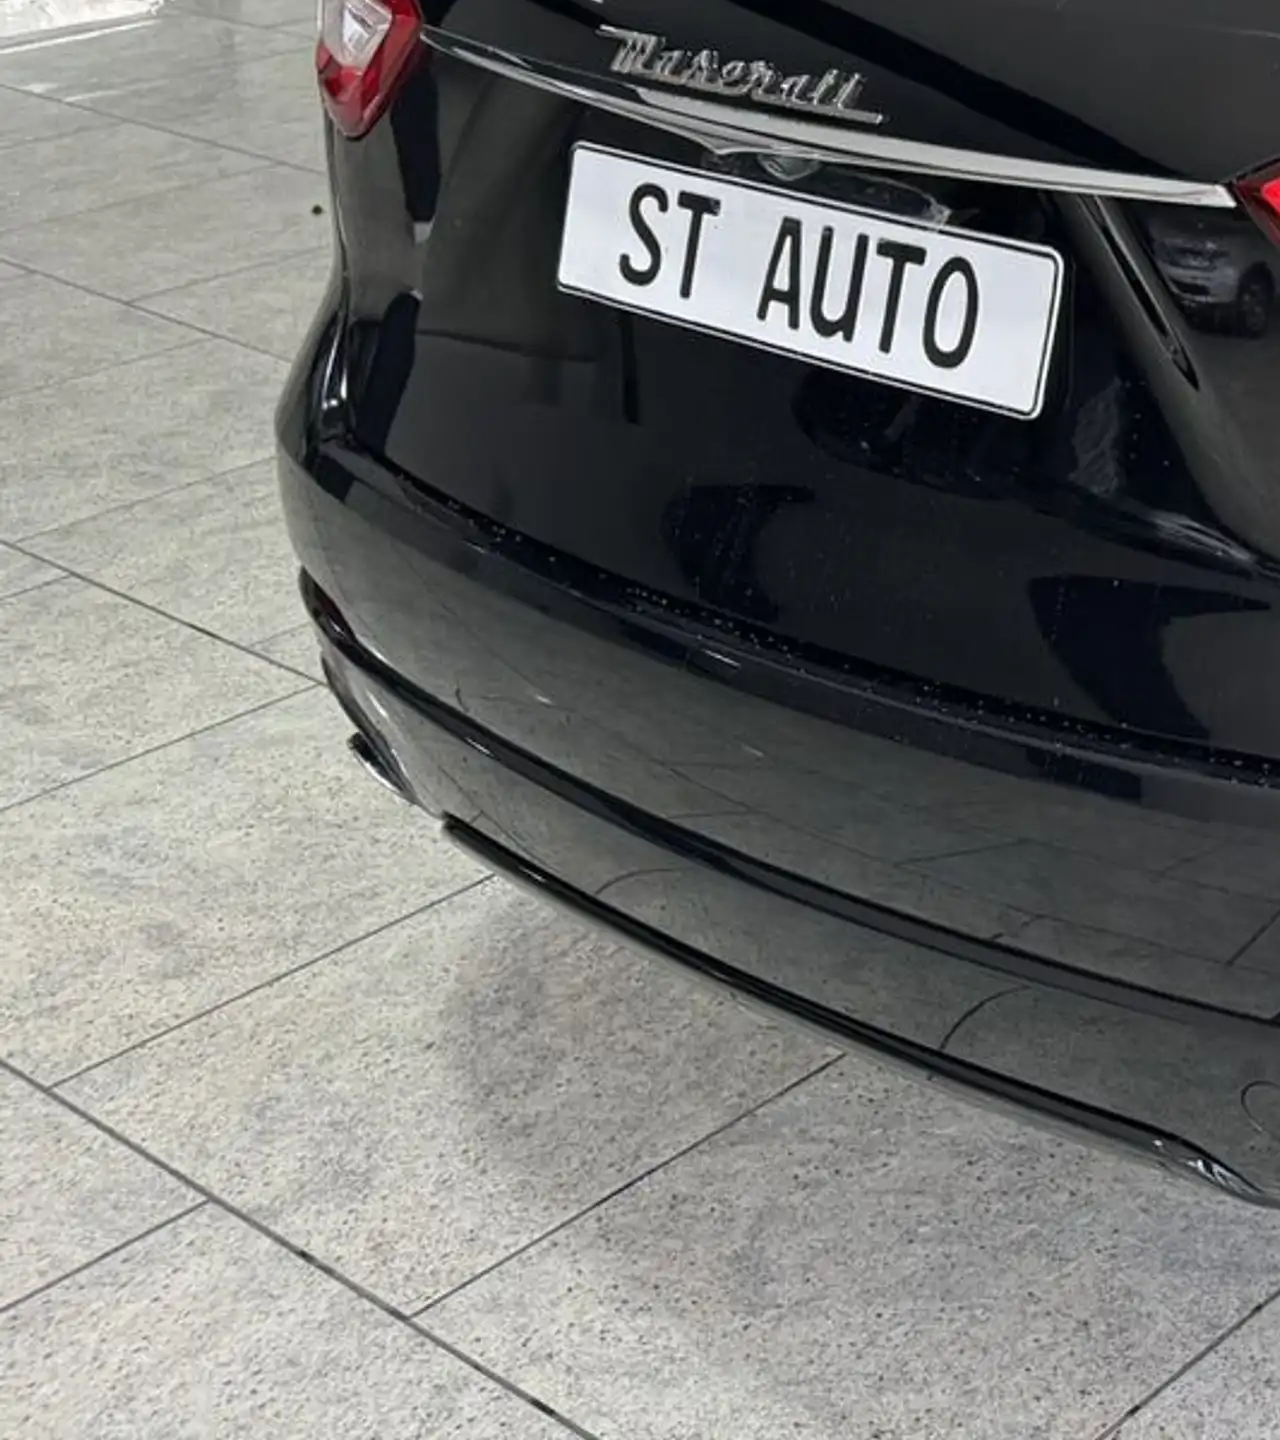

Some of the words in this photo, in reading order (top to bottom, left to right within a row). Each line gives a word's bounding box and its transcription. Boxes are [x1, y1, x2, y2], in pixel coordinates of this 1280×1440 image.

[597, 23, 883, 124] Maserati
[619, 182, 721, 300] ST
[757, 216, 979, 370] AUTO
